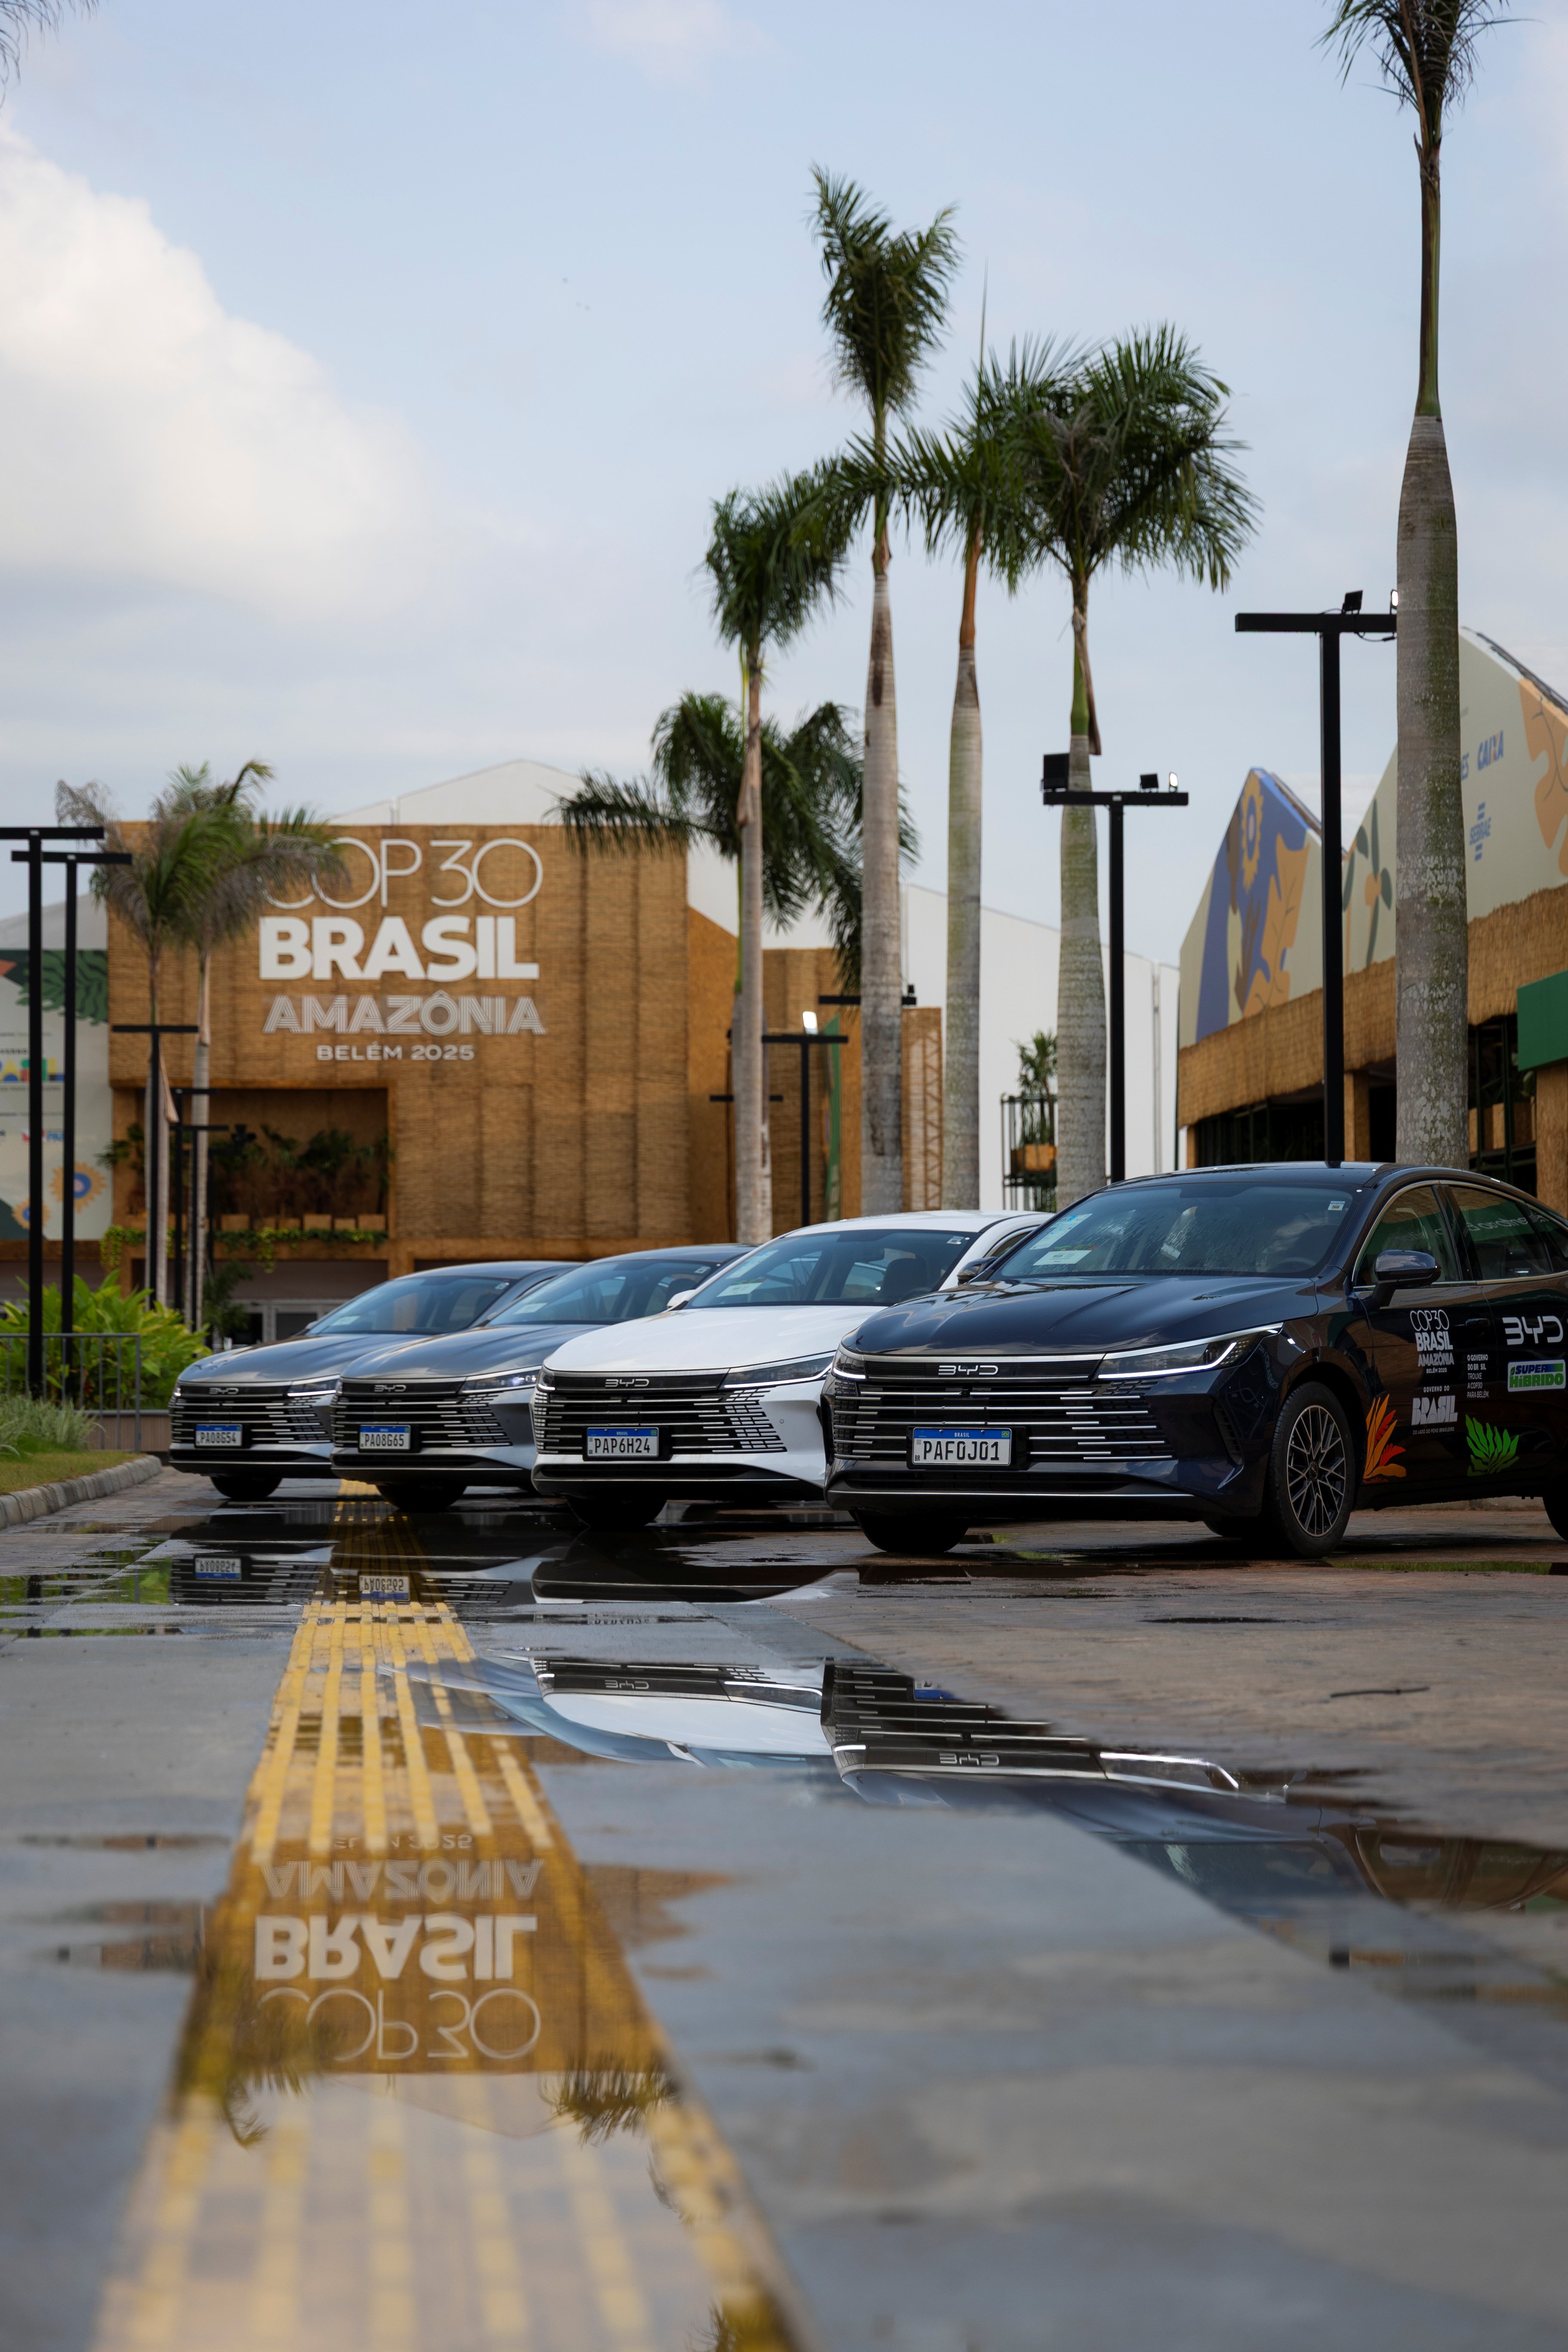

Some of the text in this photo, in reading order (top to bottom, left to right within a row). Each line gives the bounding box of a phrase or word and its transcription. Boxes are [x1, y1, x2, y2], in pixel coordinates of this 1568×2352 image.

[259, 915, 540, 982] BRASIL
[262, 990, 547, 1036] AMAZÔNIA
[317, 1042, 475, 1061] BELÉM 2025
[1410, 1309, 1449, 1331] COP30
[1502, 1316, 1564, 1345] BYD
[1415, 1331, 1453, 1352] BRASIL
[1418, 1351, 1455, 1367] AMAZÔNIA
[938, 1365, 998, 1375] BYD
[1515, 1364, 1548, 1375] SUPER
[605, 1379, 649, 1387] BYD
[1411, 1395, 1458, 1426] BRASIL
[594, 1438, 650, 1453] PAP6H24
